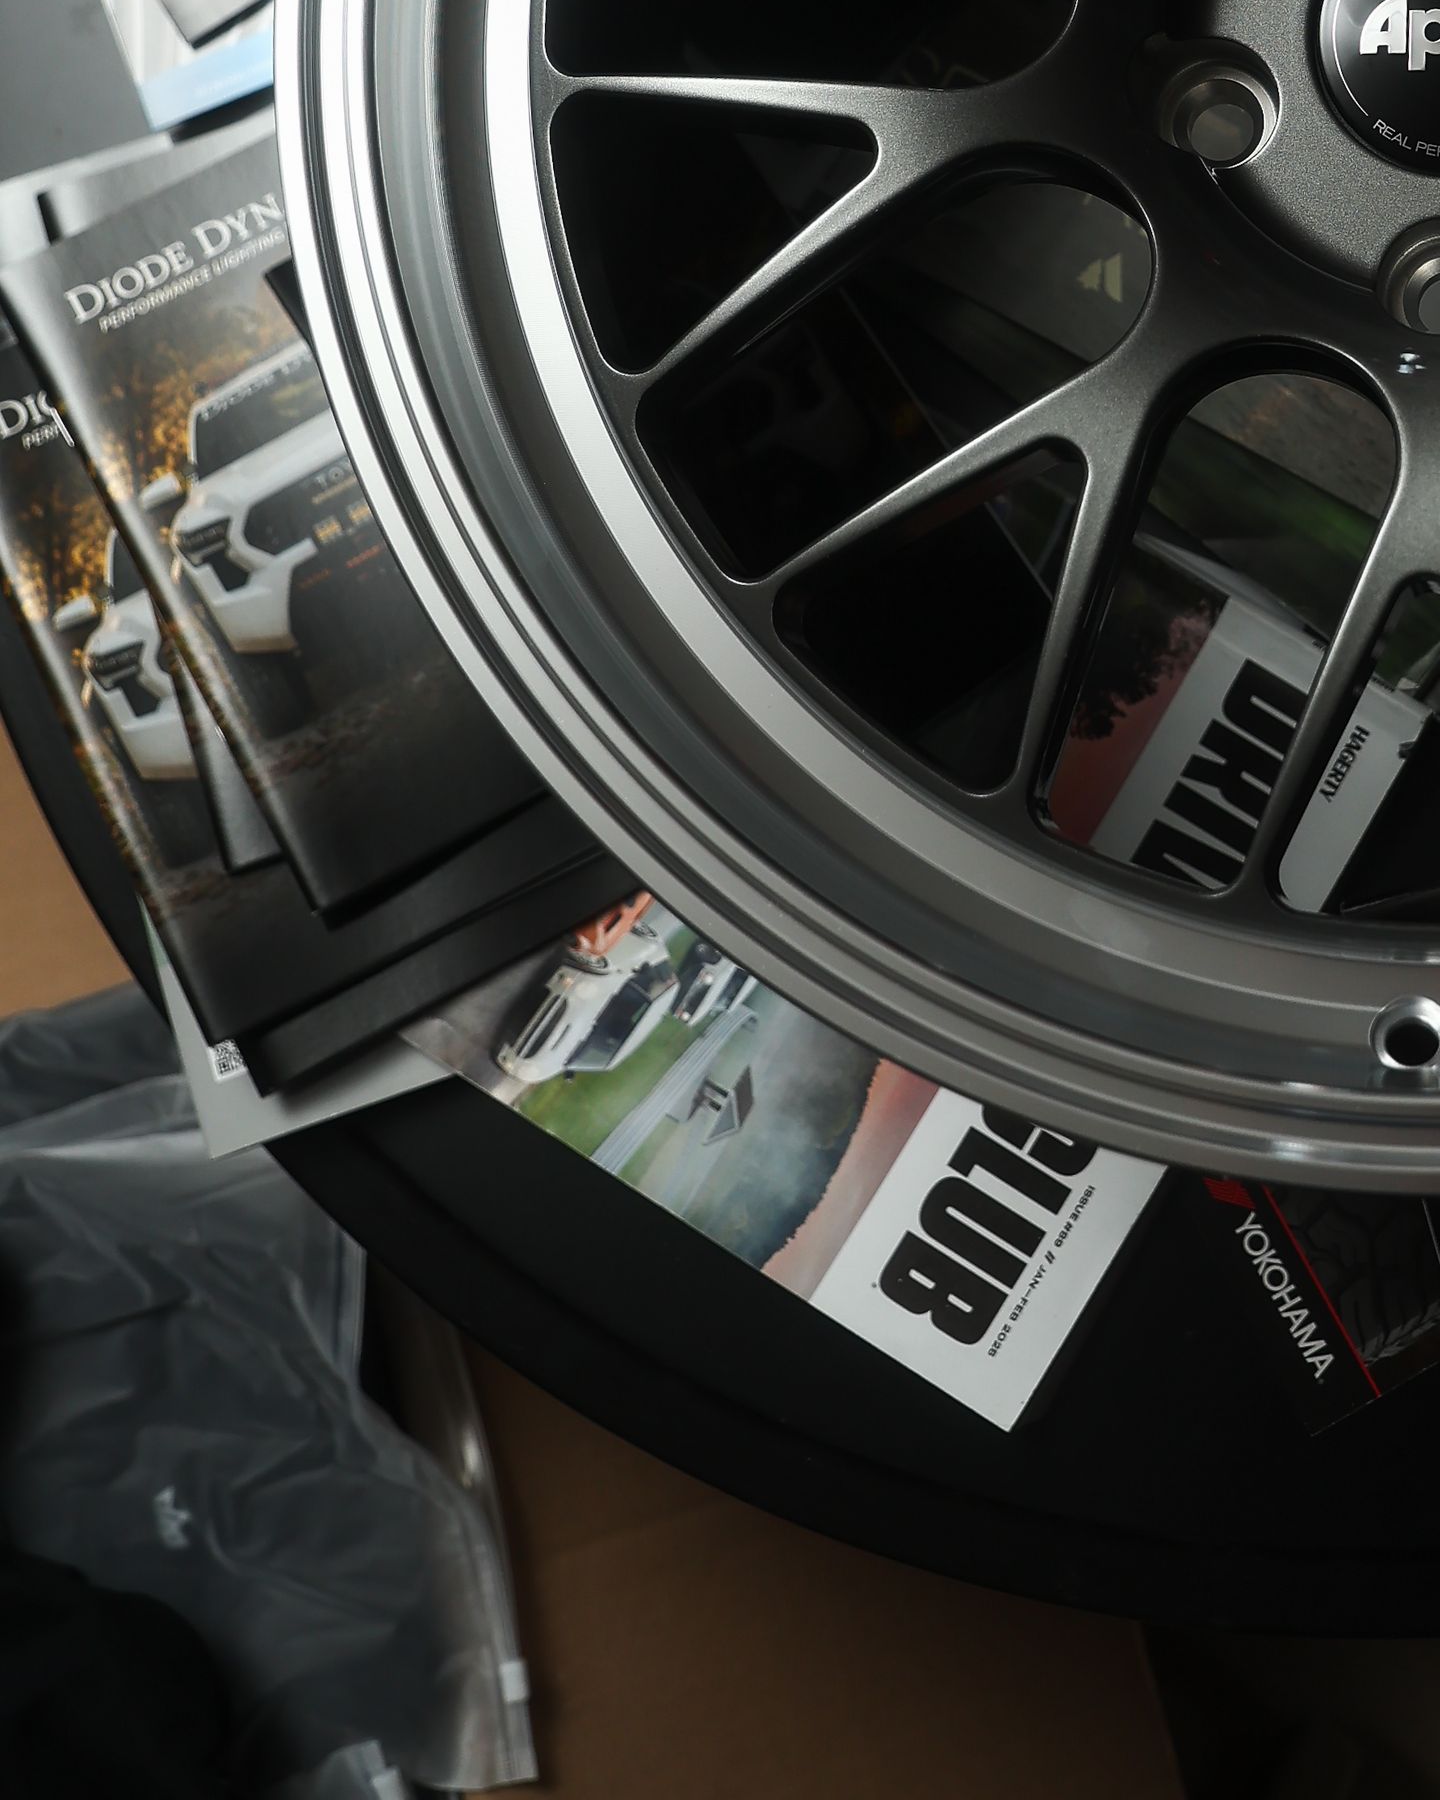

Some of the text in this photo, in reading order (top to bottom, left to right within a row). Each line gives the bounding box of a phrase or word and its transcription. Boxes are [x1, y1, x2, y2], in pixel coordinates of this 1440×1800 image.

[1372, 118, 1413, 151] REAL
[64, 240, 195, 325] DIODE
[98, 265, 210, 334] PERFORMANCE
[1318, 724, 1370, 803] HAGERTY
[1068, 1184, 1096, 1222] ISSUE
[1234, 1210, 1335, 1380] YOKOHAMA
